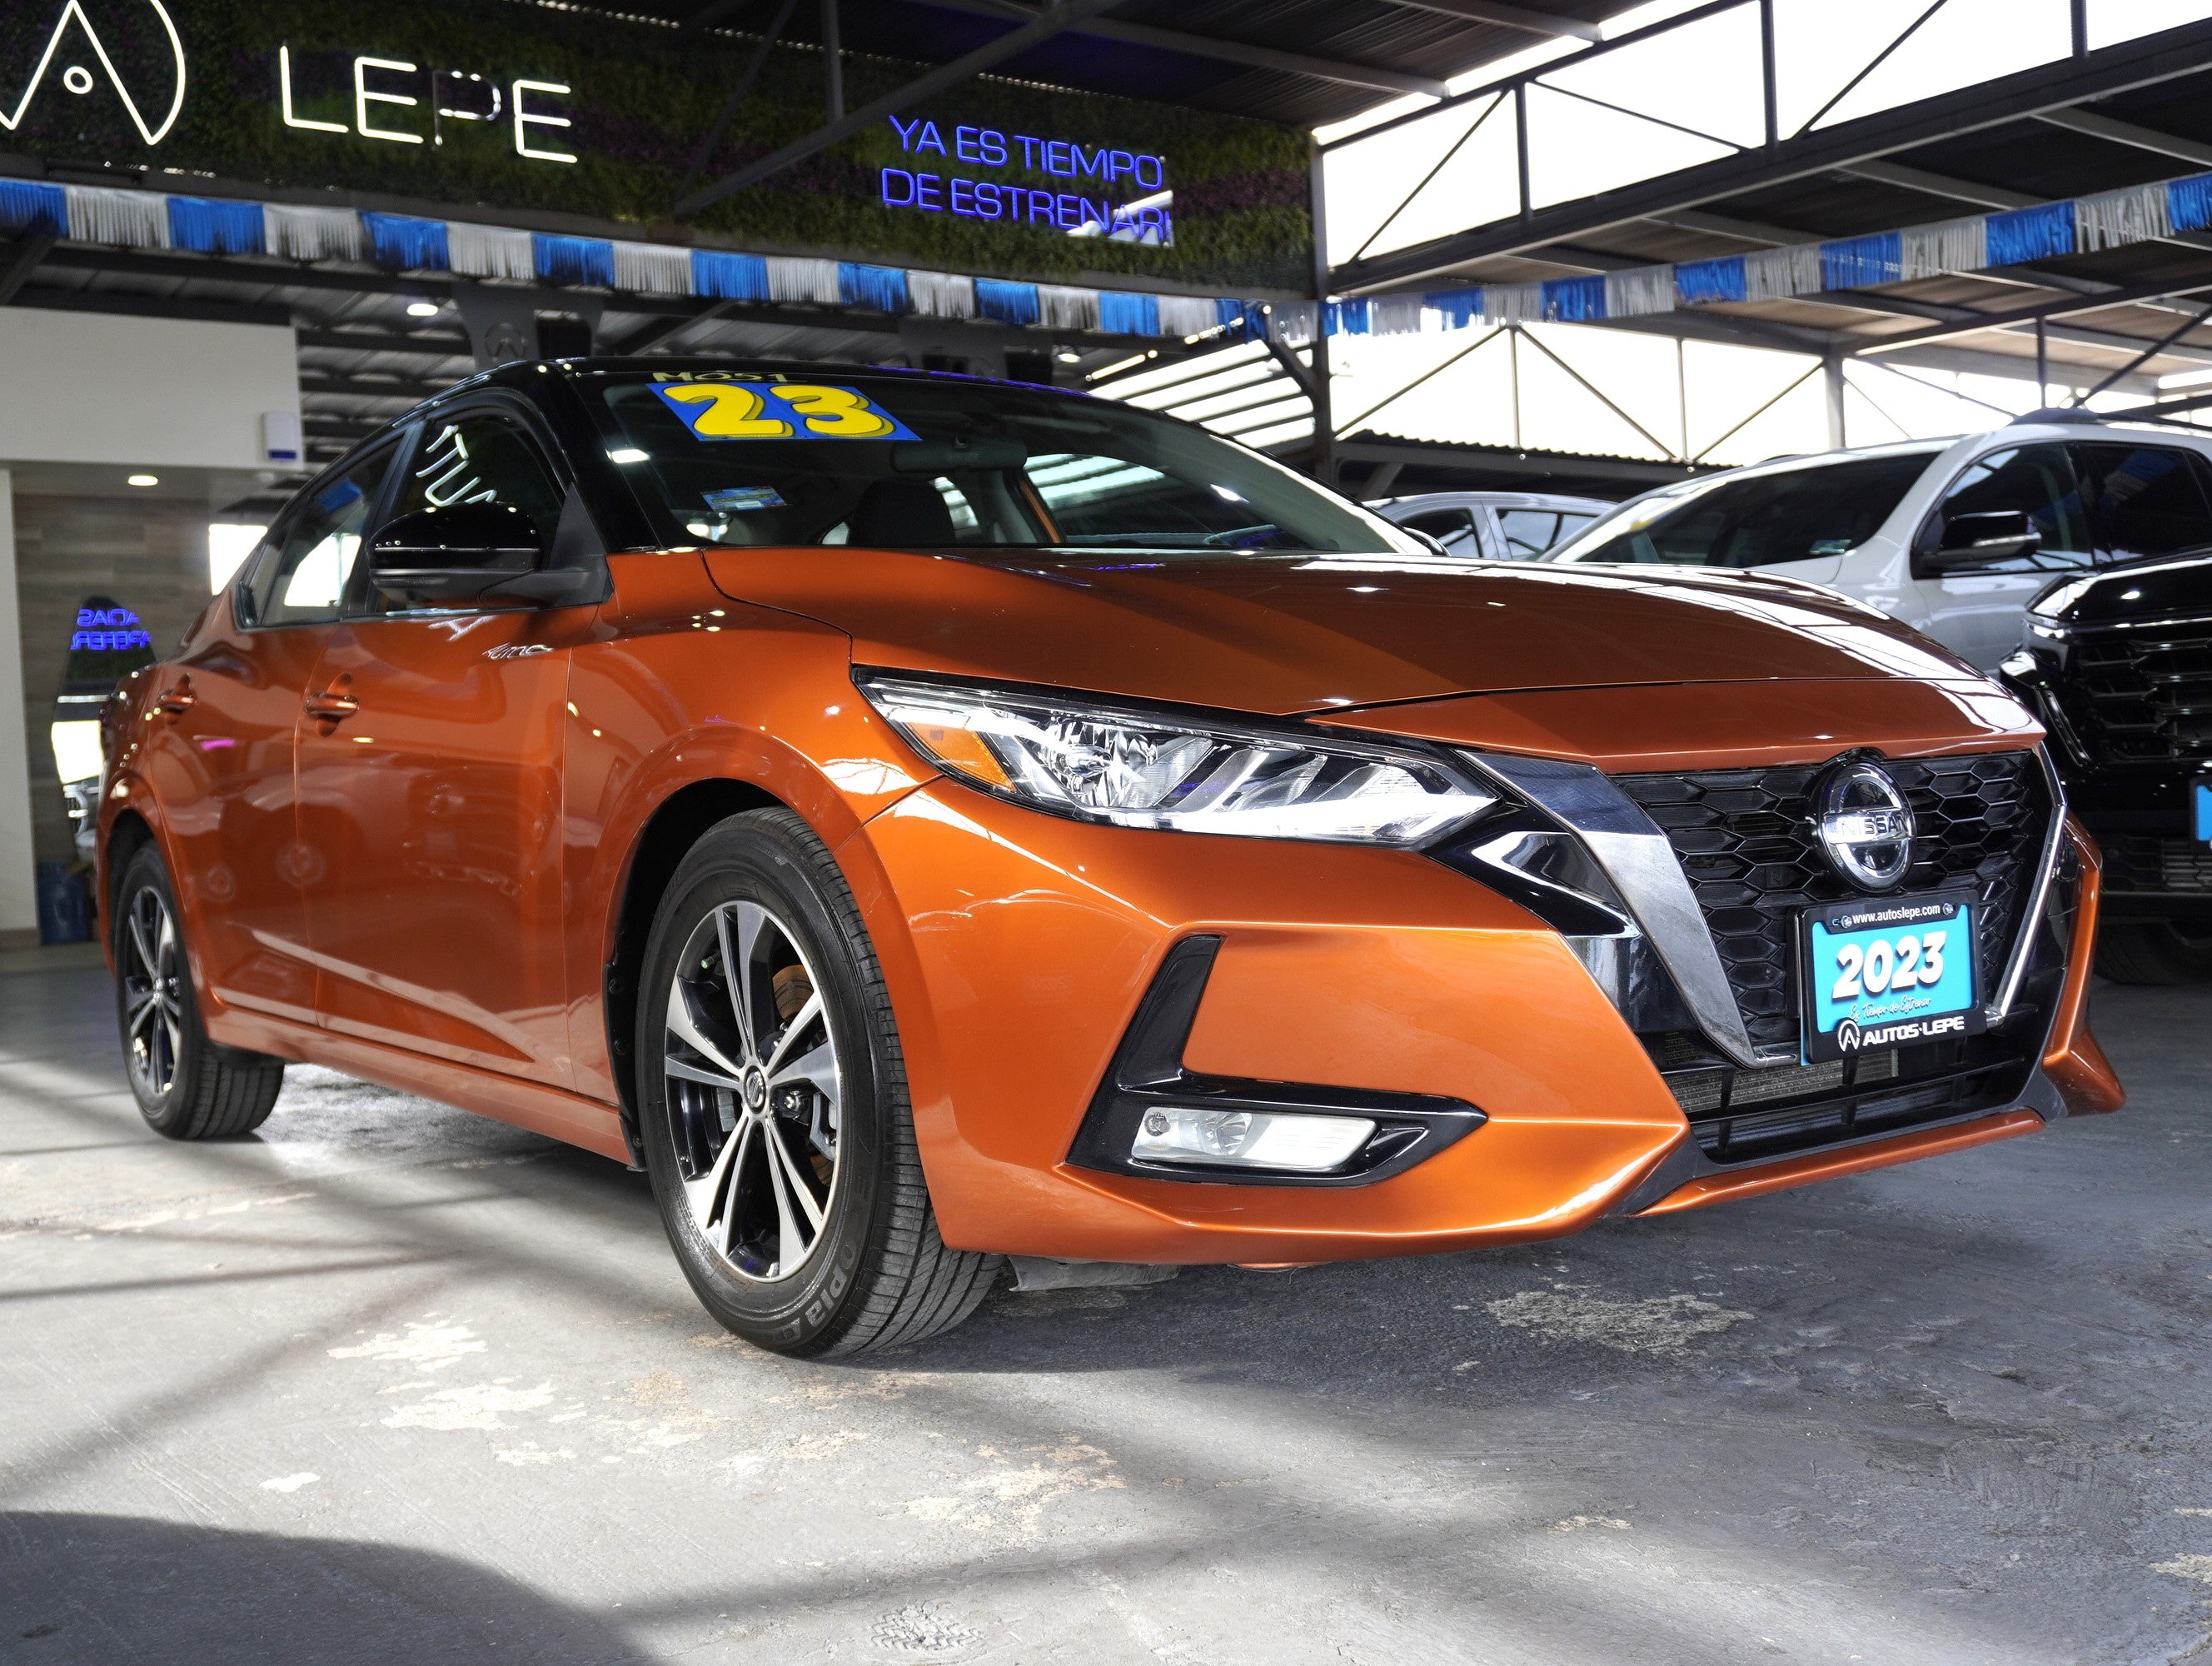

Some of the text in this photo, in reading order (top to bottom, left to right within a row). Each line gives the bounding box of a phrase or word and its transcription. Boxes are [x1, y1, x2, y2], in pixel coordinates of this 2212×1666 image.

[280, 42, 578, 165] LEPE
[889, 114, 1163, 190] YA ES TIEMPO
[881, 167, 943, 212] DE
[662, 383, 896, 438] 23
[1841, 813, 1910, 836] NISSAN
[1852, 904, 1941, 925] www.autoslepe.com
[1832, 930, 1947, 1000] 2023
